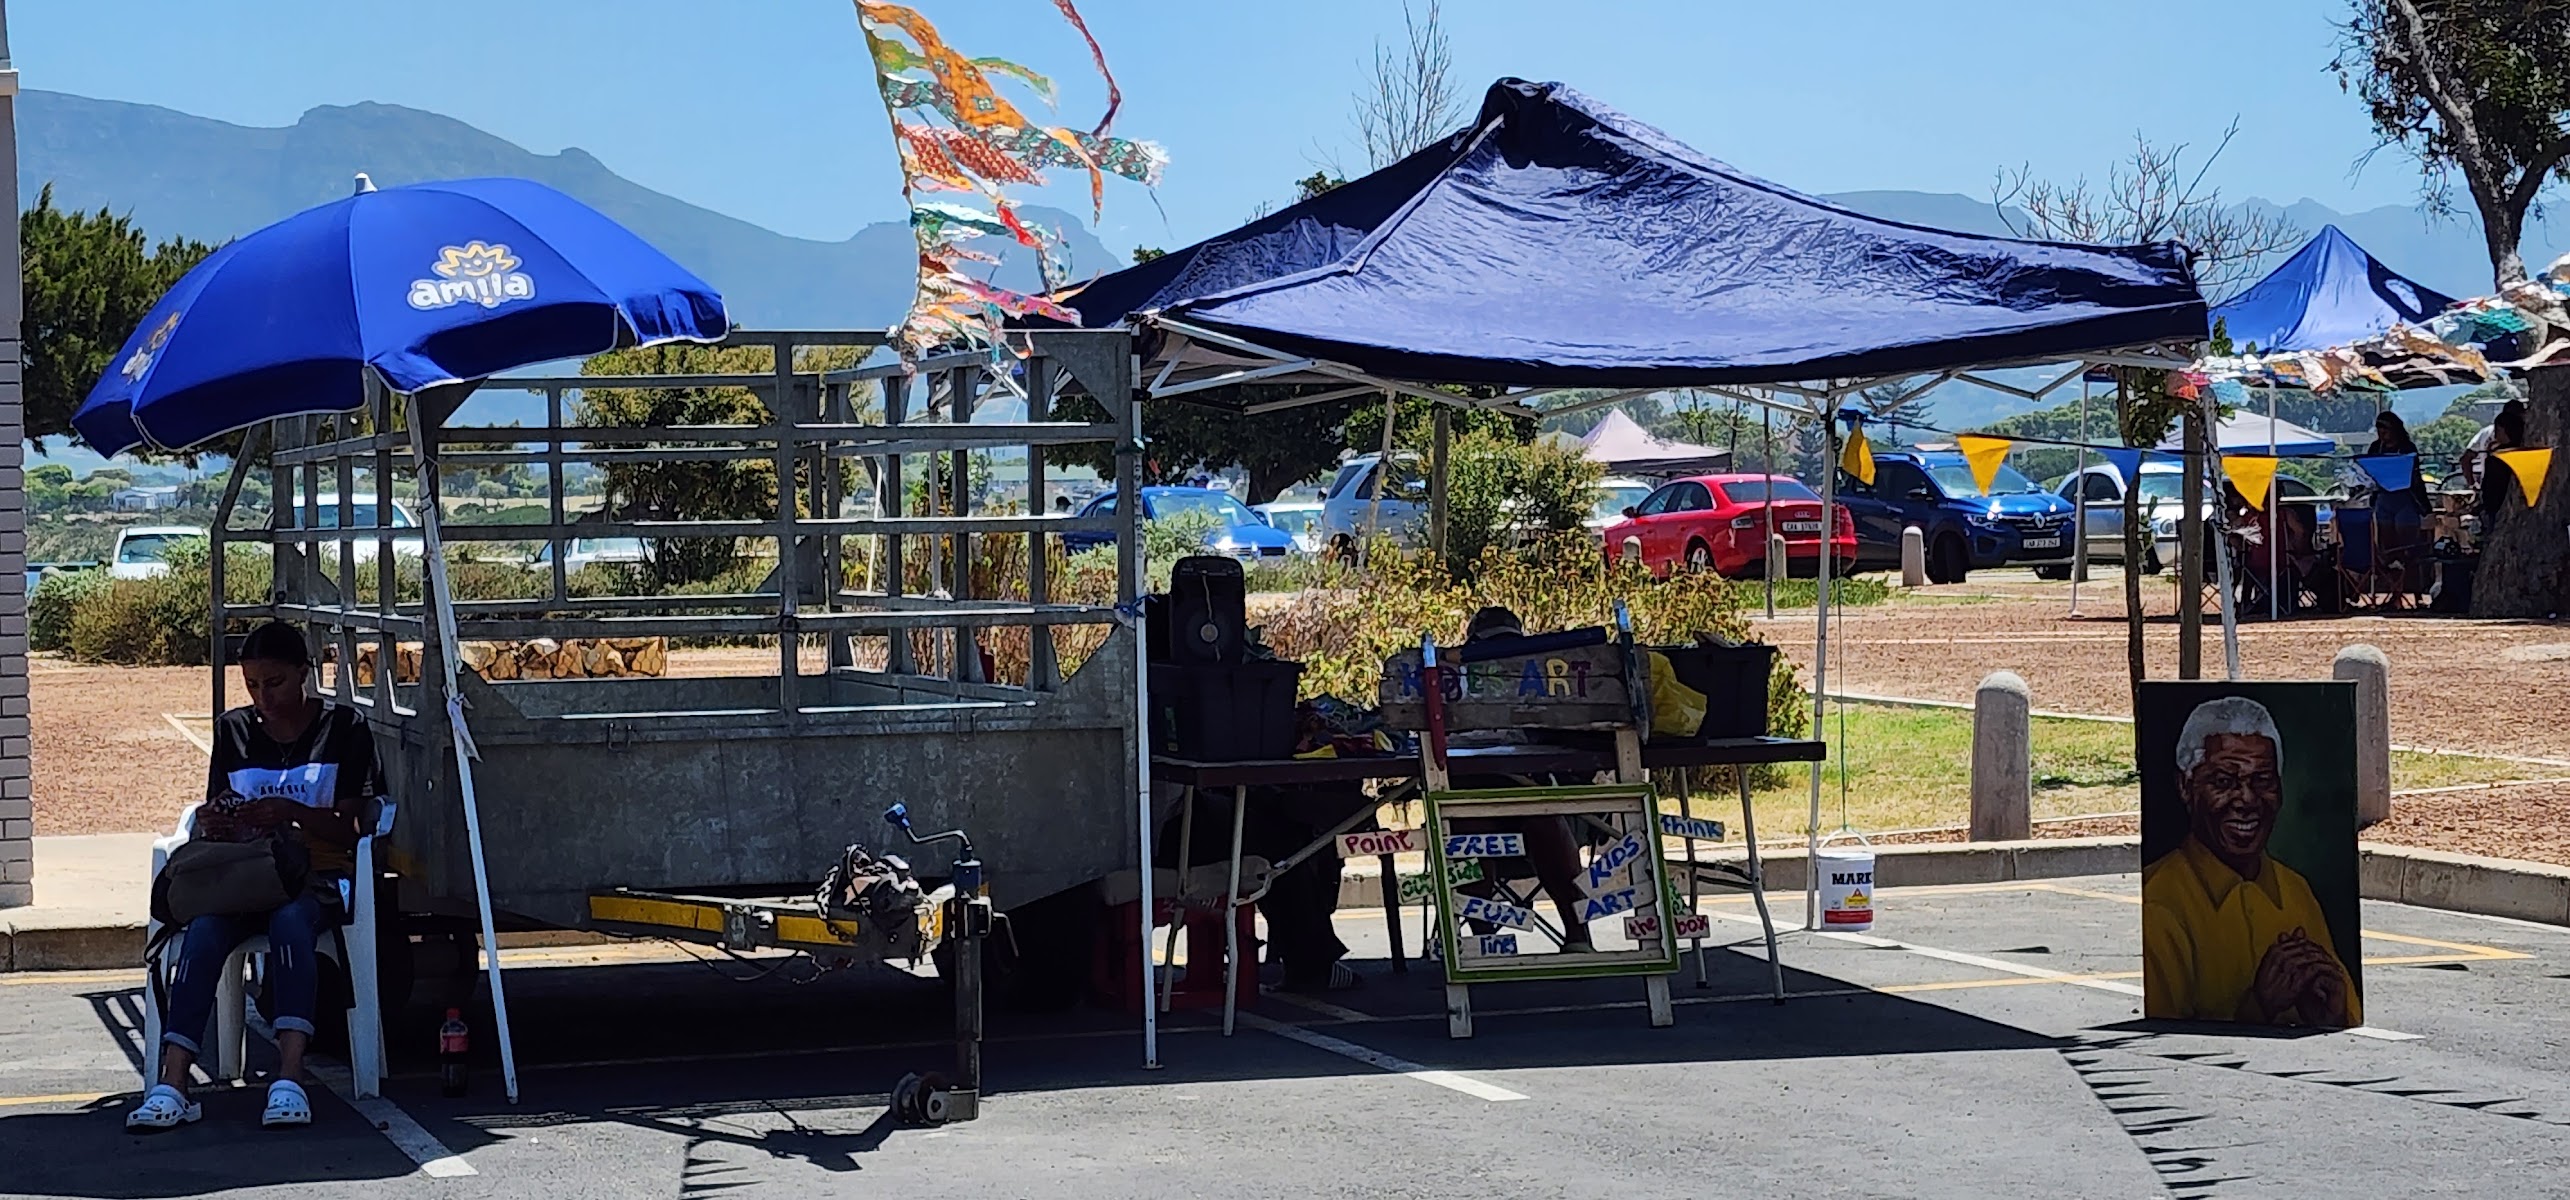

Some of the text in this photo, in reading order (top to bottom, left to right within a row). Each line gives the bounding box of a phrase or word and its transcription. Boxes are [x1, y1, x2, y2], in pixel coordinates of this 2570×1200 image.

[1518, 658, 1592, 698] ART
[1445, 835, 1519, 856] FREE
[1588, 835, 1639, 889] KIDS
[1463, 899, 1527, 925] FUN
[1584, 889, 1636, 920] ART
[1628, 915, 1709, 937] the box
